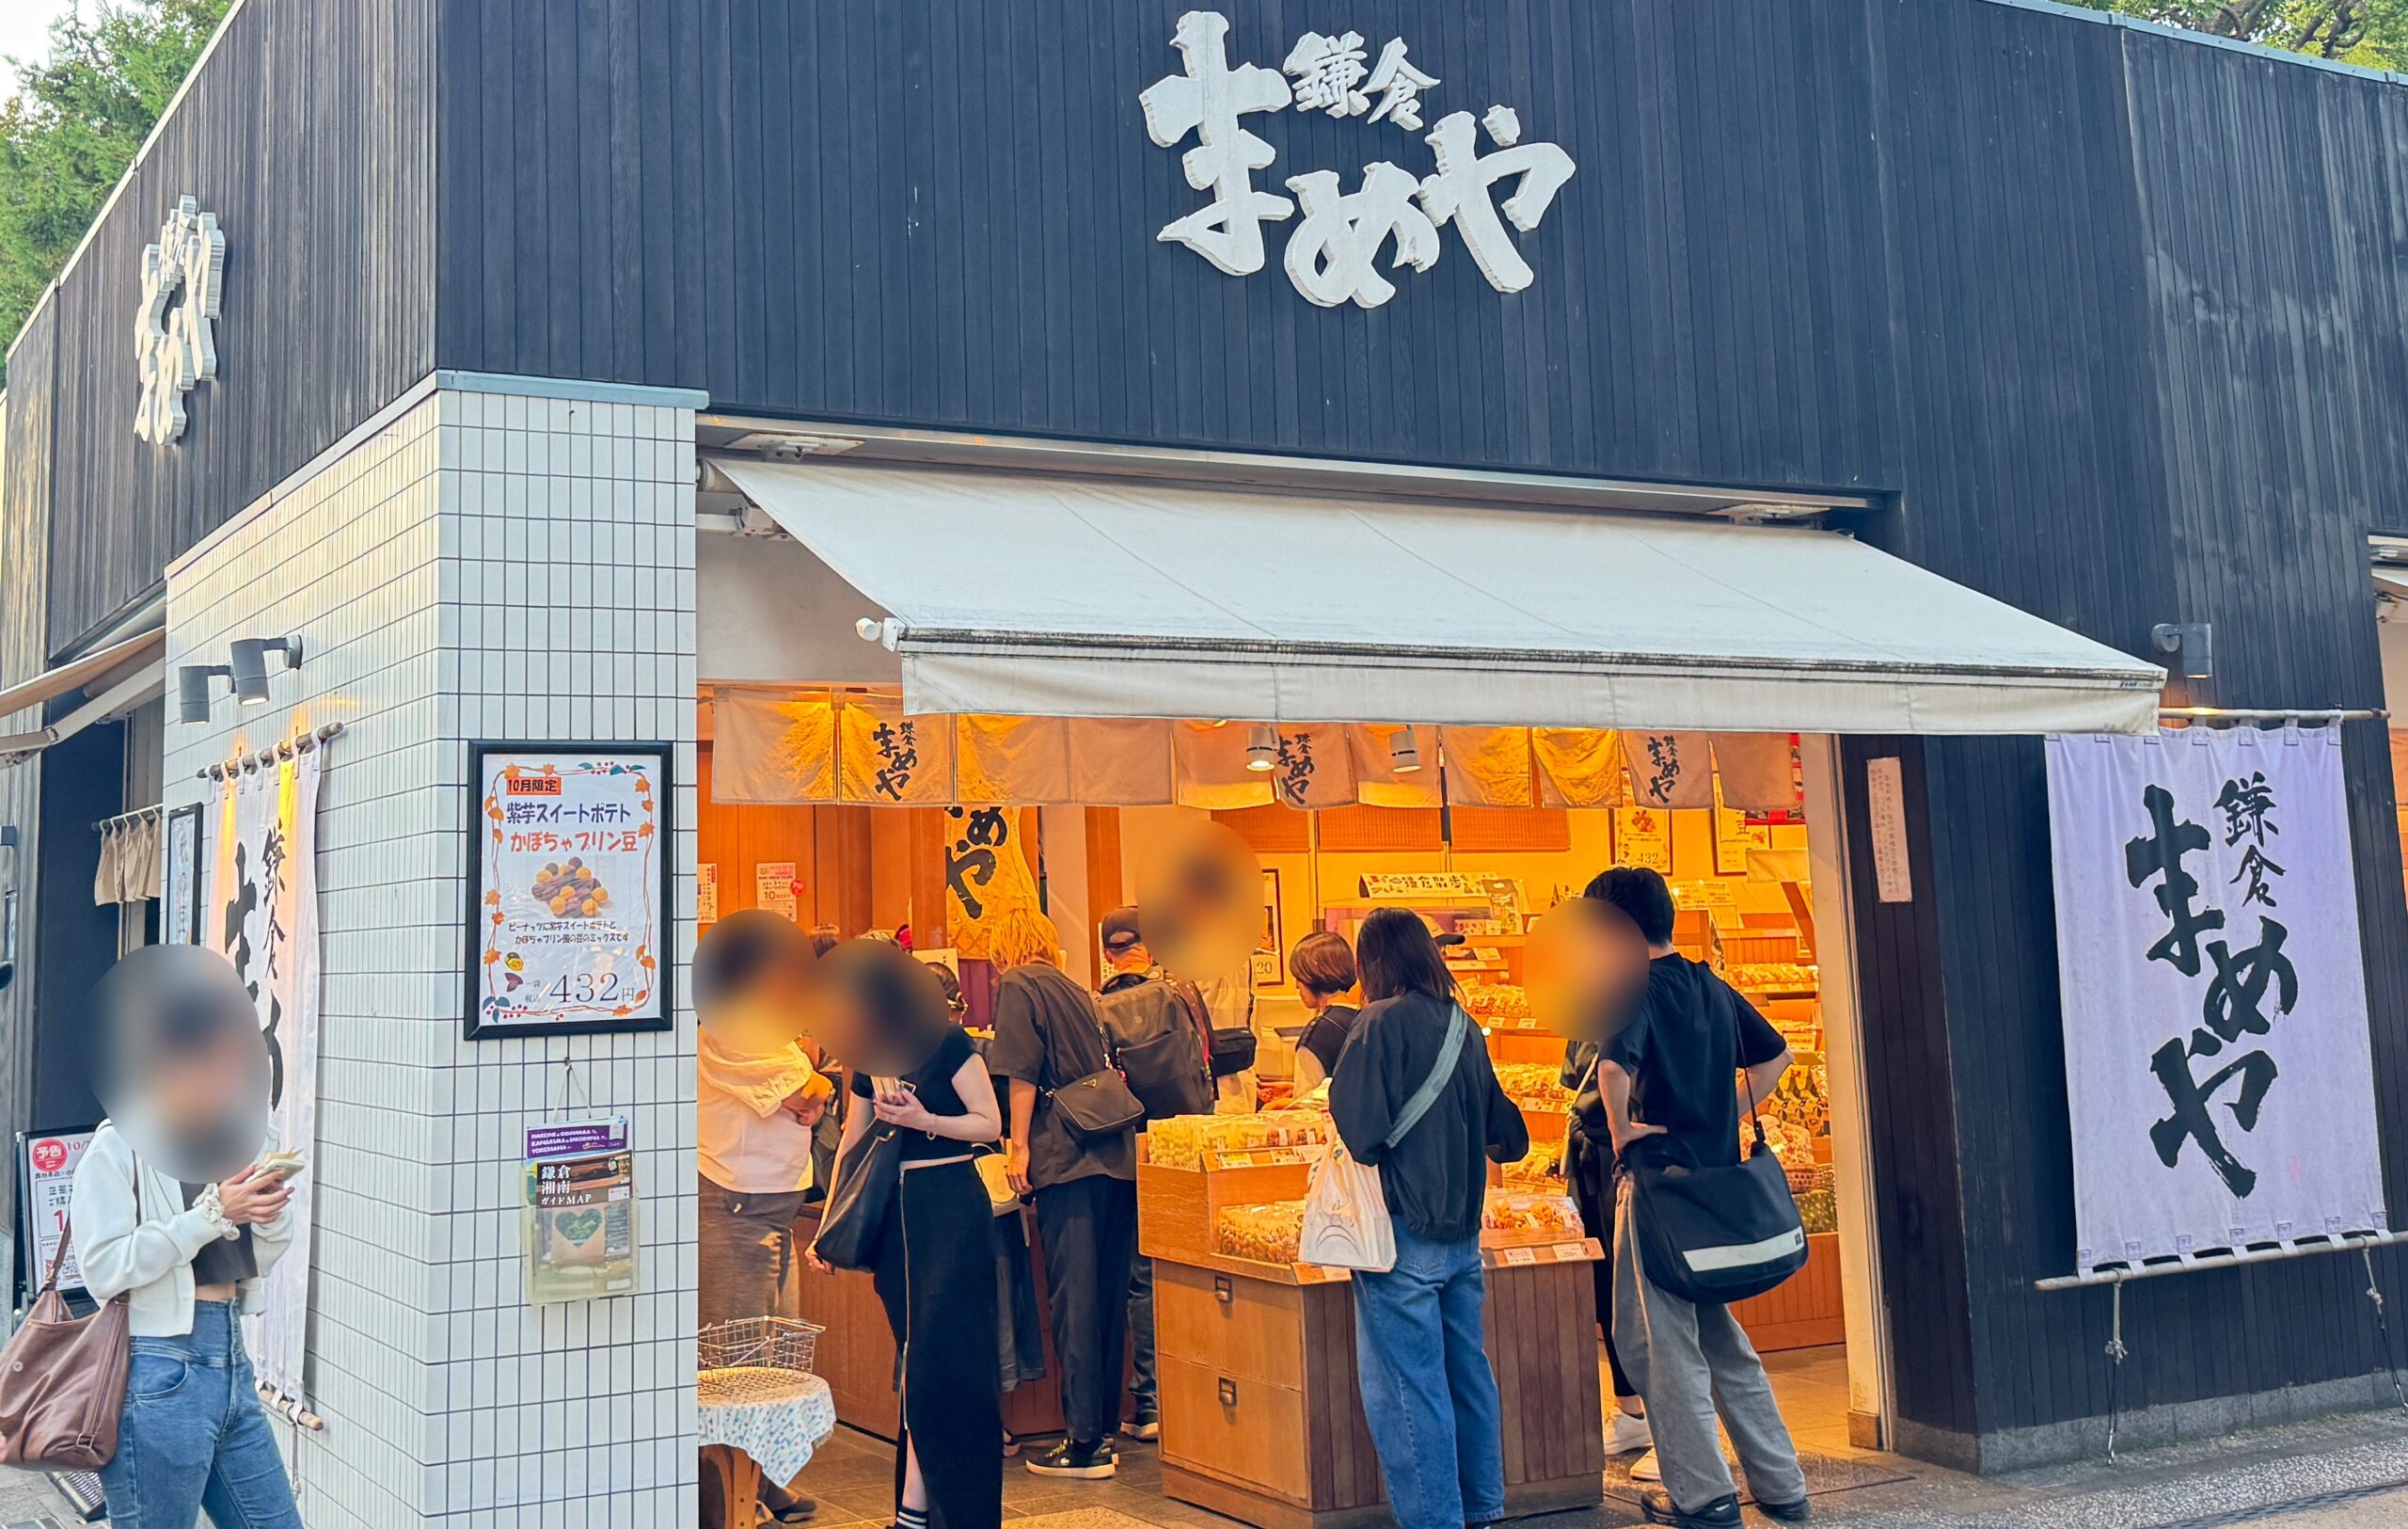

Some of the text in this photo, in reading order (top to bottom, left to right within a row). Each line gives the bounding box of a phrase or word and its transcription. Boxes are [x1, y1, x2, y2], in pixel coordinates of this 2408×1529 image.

[1283, 30, 1441, 131] 鎌倉
[1139, 10, 1576, 309] まめや
[508, 779, 558, 792] 10月限定
[873, 722, 918, 802] まめや
[1647, 736, 1681, 804] まめや
[507, 802, 631, 825] 紫芋スイートポテト
[510, 831, 639, 852] かぼちゃプリン豆
[2213, 771, 2288, 908] 鎌倉
[945, 806, 1007, 920] めや
[2125, 784, 2299, 1200] まめや
[36, 1145, 62, 1159] 予告
[541, 1193, 593, 1205] ガイドMAP
[542, 1180, 571, 1195] 湘南
